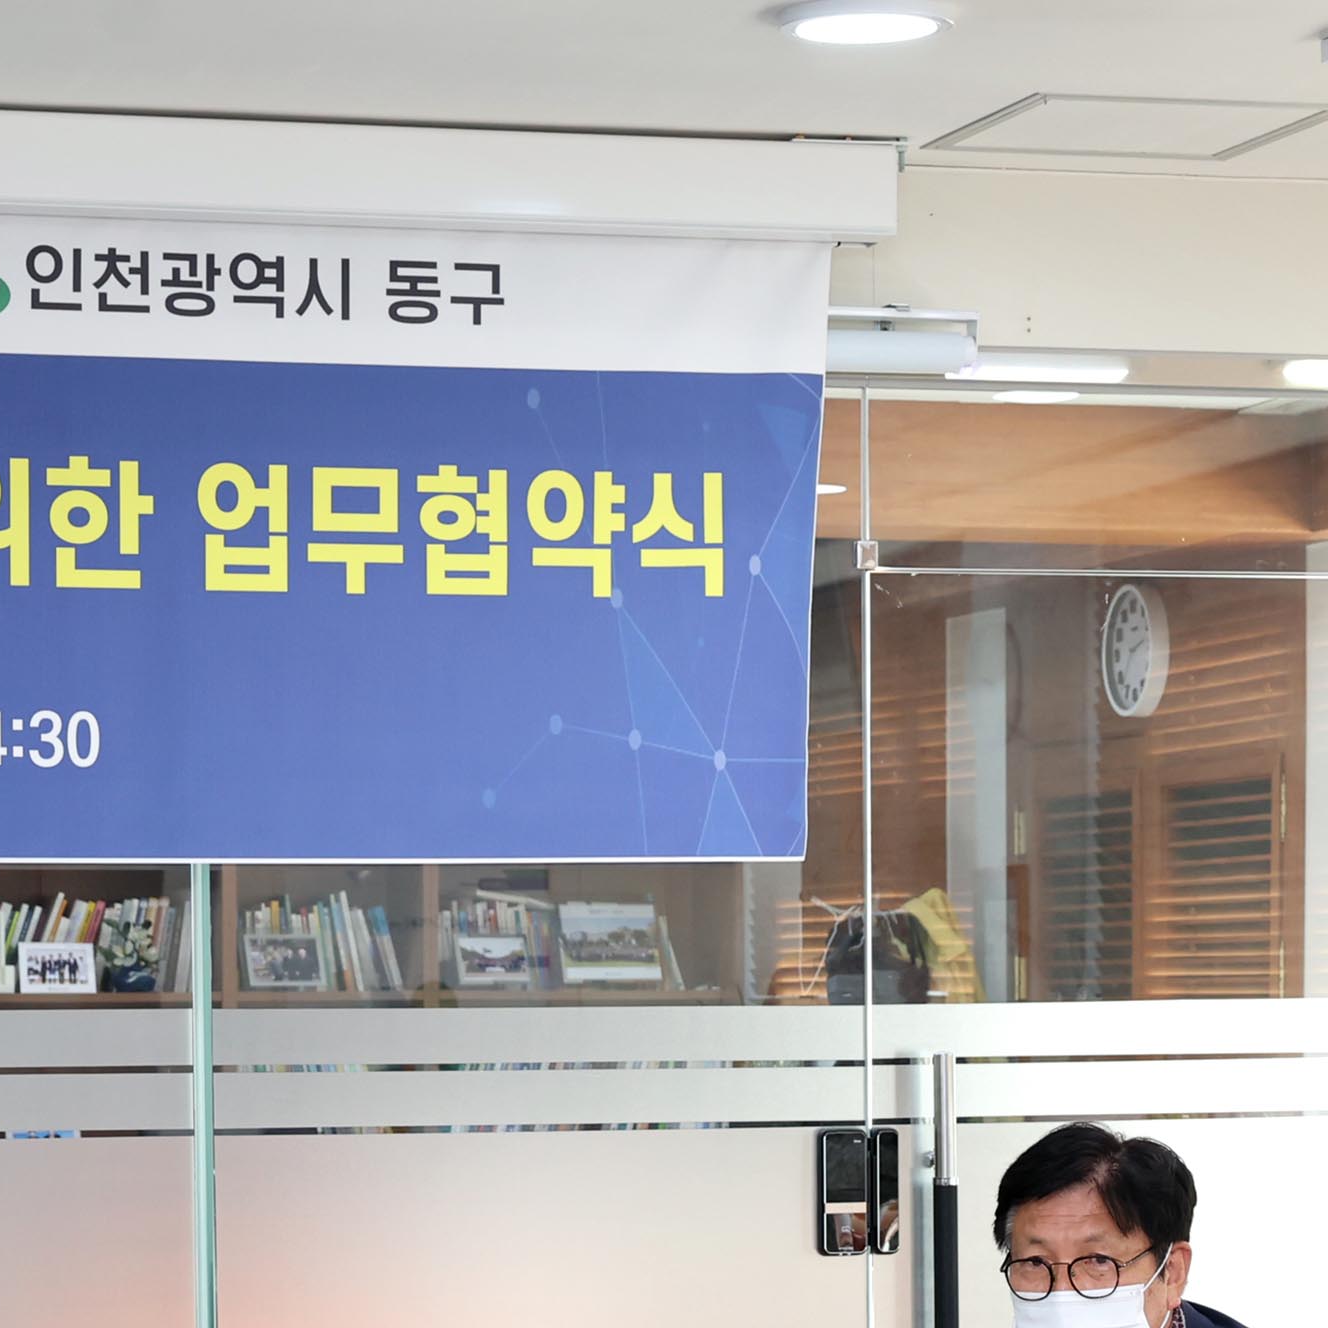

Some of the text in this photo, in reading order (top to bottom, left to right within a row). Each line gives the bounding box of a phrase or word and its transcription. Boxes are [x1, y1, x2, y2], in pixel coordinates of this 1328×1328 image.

[25, 244, 506, 325] 인천광역시 동구
[197, 463, 724, 597] 업무협약식
